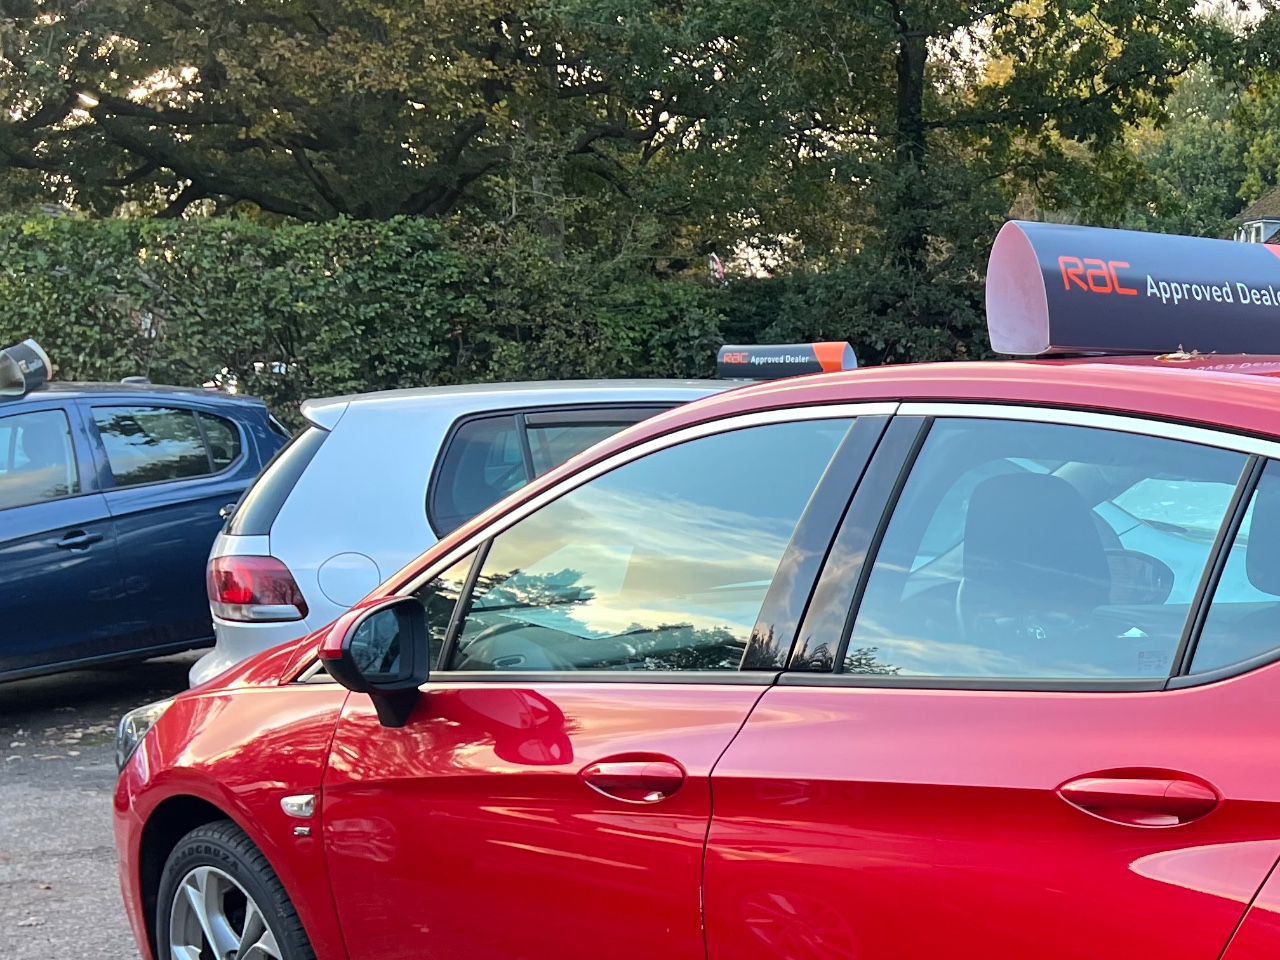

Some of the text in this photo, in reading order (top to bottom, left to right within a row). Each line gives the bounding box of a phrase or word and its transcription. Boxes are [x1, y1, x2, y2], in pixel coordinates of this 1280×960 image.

[1146, 274, 1234, 305] Approved
[750, 355, 784, 365] Approved
[785, 355, 810, 364] Dealer
